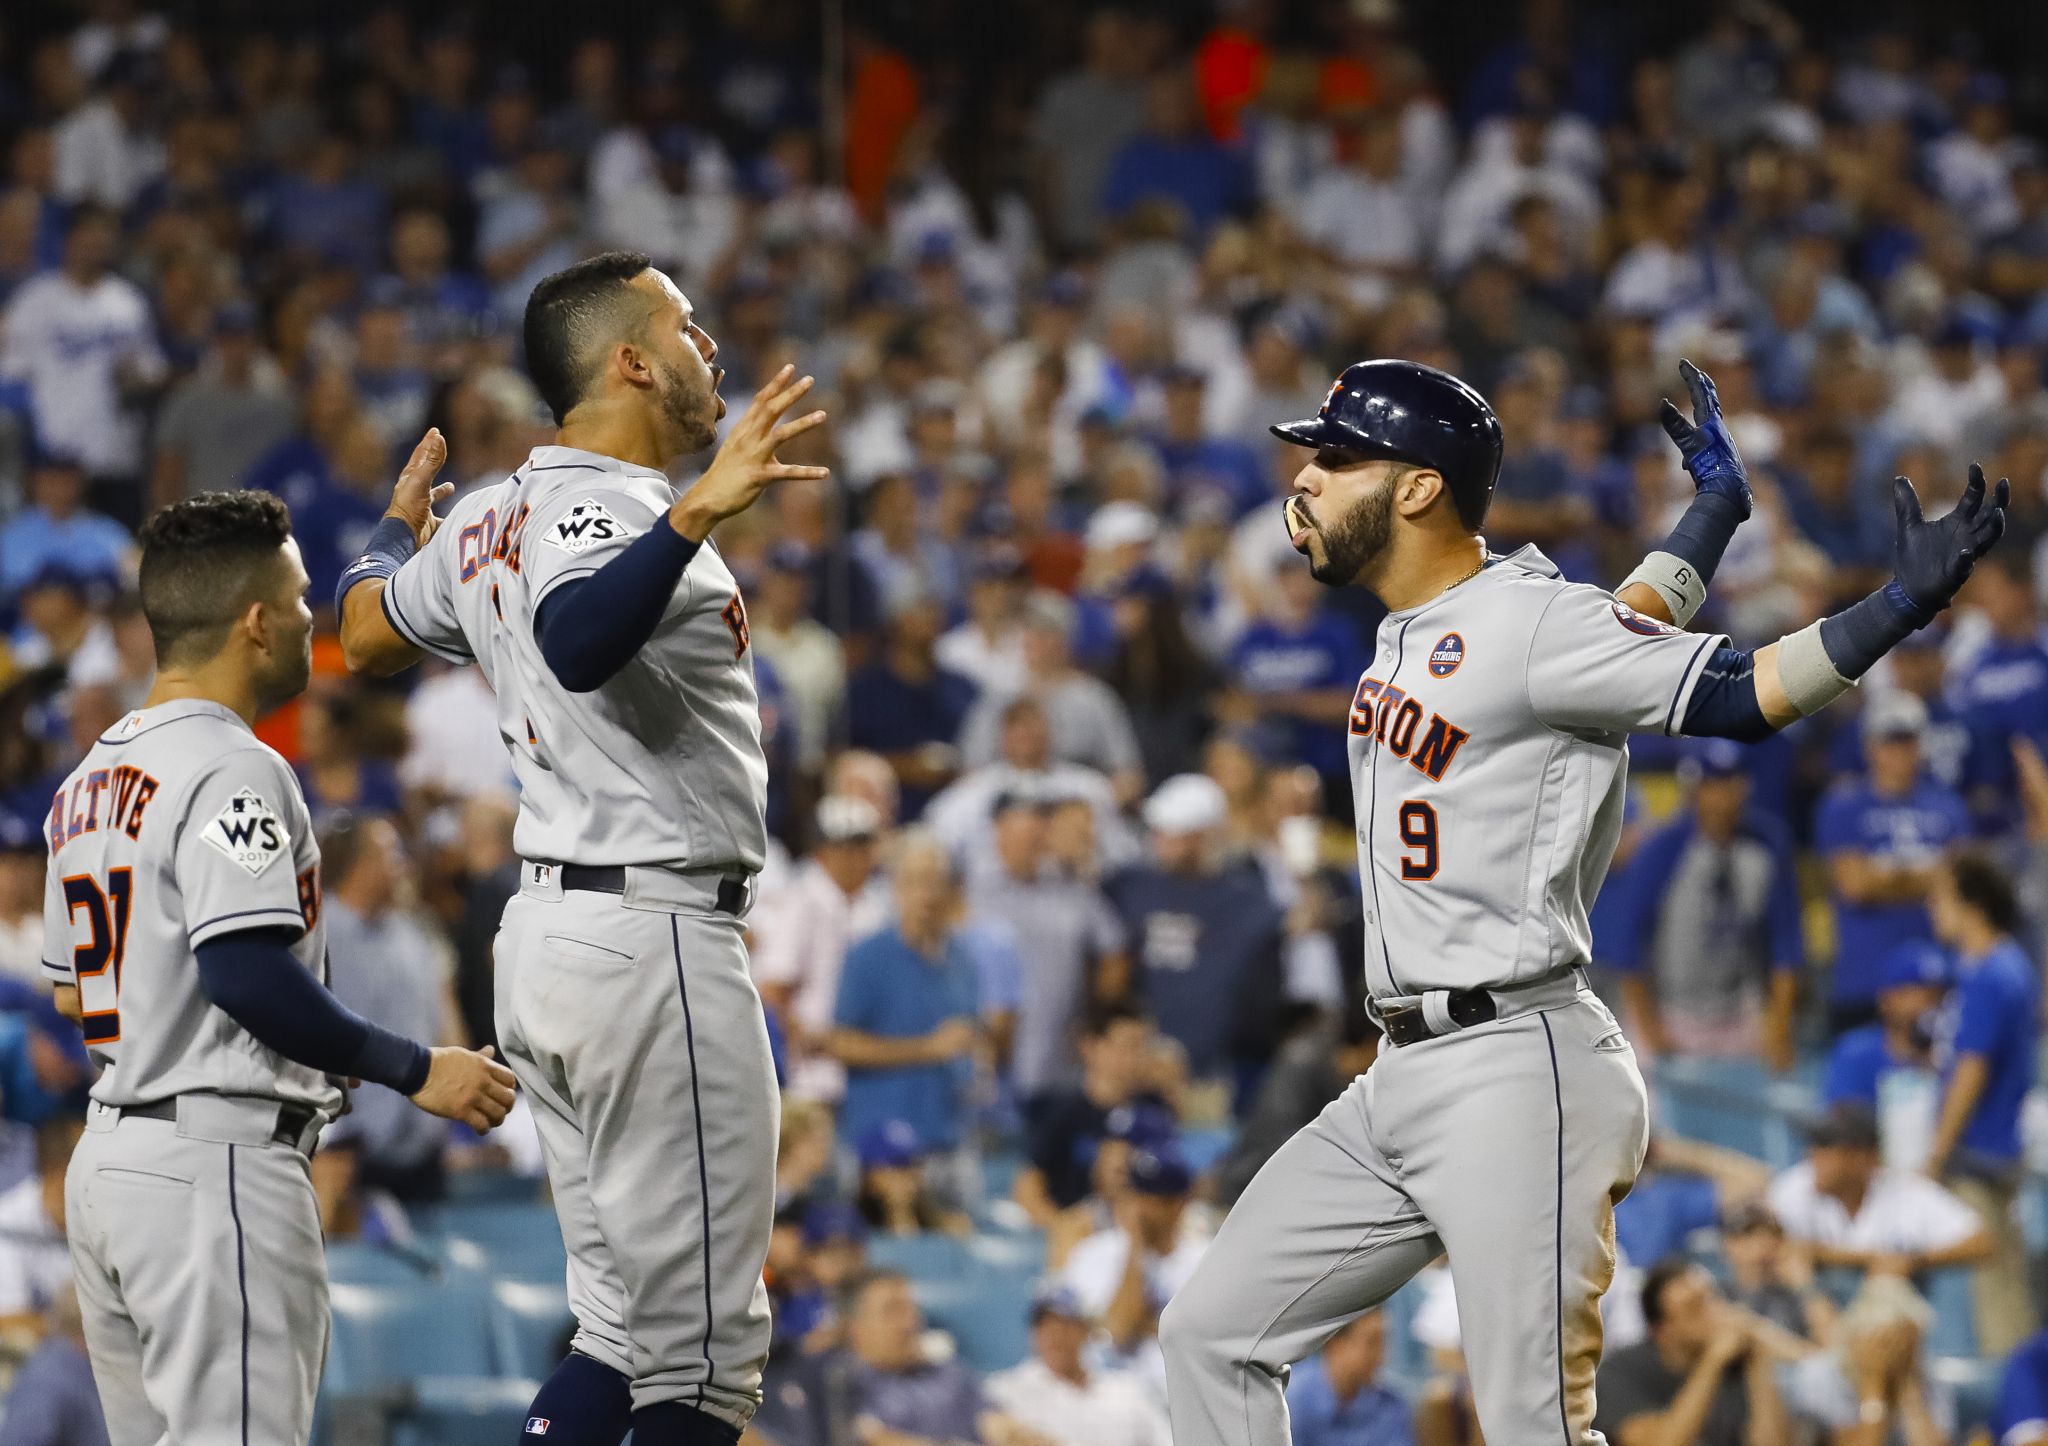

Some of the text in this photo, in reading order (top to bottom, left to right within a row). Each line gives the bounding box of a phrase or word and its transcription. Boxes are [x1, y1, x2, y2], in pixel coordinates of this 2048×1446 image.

[557, 517, 613, 541] WS
[1431, 651, 1462, 662] STRONG
[218, 817, 279, 851] WS
[1399, 800, 1440, 881] 9
[237, 852, 270, 862] 2017
